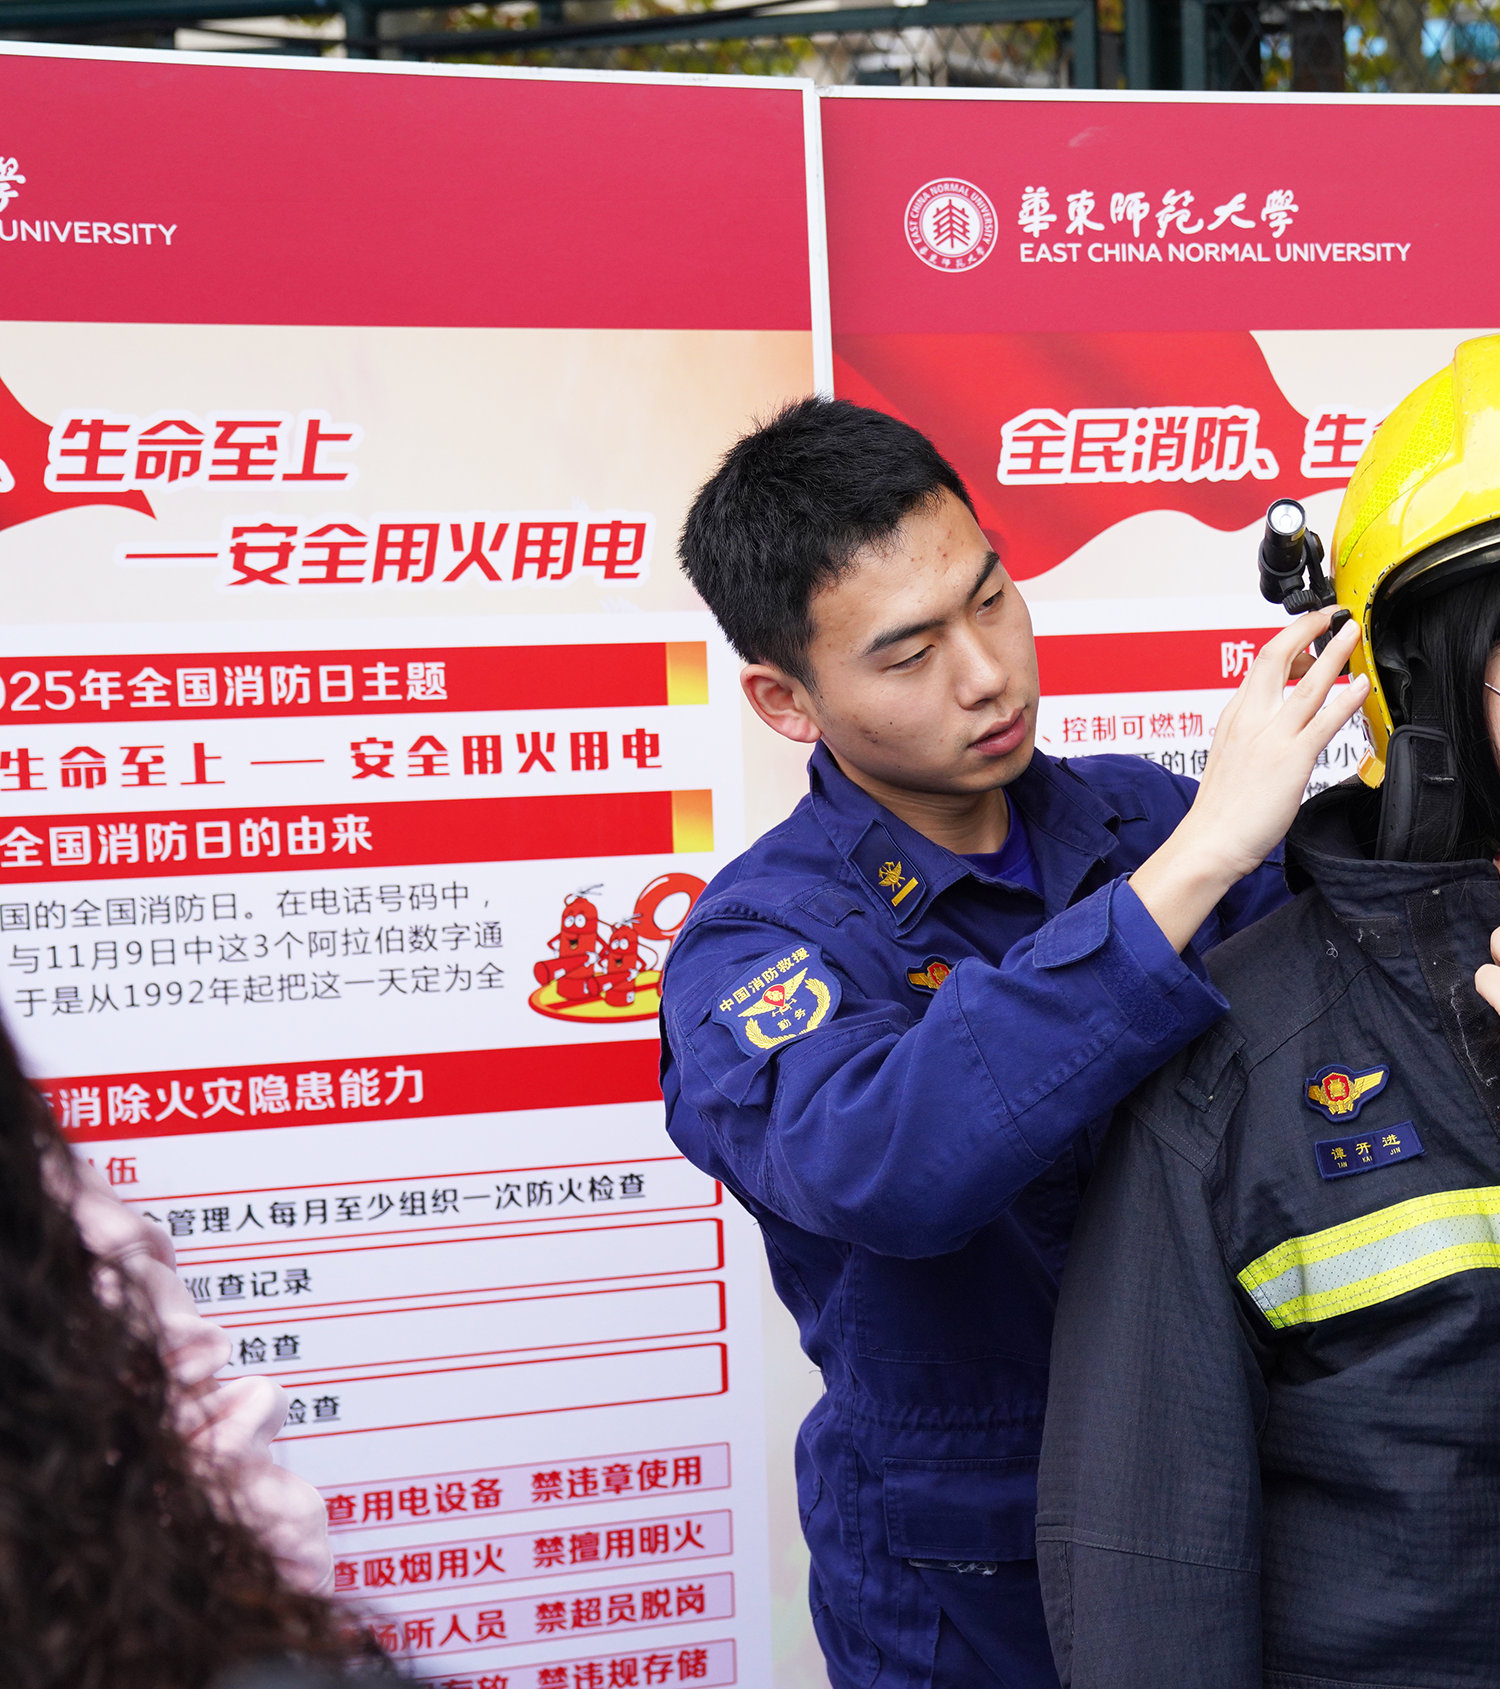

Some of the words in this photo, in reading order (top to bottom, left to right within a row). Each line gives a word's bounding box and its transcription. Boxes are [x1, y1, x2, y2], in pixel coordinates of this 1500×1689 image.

[0, 219, 177, 245] UNIVERSITY
[910, 191, 931, 219] CHINA
[929, 182, 969, 197] NORMAL
[970, 192, 993, 245] UNIVERSITY
[1020, 243, 1081, 263] EAST
[1087, 243, 1162, 263] CHINA
[1167, 243, 1271, 262] NORMAL
[1275, 243, 1411, 262] UNIVERSITY
[56, 418, 354, 484] 生命至上
[1007, 413, 1386, 476] 全民消防、生
[0, 661, 448, 712] 25年全国消防日主题
[0, 742, 226, 791] 生命至上
[350, 728, 662, 781] 安全用火用电
[0, 813, 373, 868] 全国消防日的由来
[8, 920, 504, 974] 与11月9日中这3个阿拉伯数字通
[14, 961, 505, 1018] 于是从1992年起把这一天定为全
[719, 947, 810, 1012] 中国消防救援
[42, 1064, 425, 1128] 消除火灾隐患能力
[143, 1173, 646, 1237] 管理人每月至少组织一次防火检查
[228, 1334, 301, 1367] 检查
[531, 1455, 702, 1504] 禁违章使用
[533, 1519, 705, 1569] 禁擅用明火
[535, 1583, 706, 1634] 禁超员脱岗
